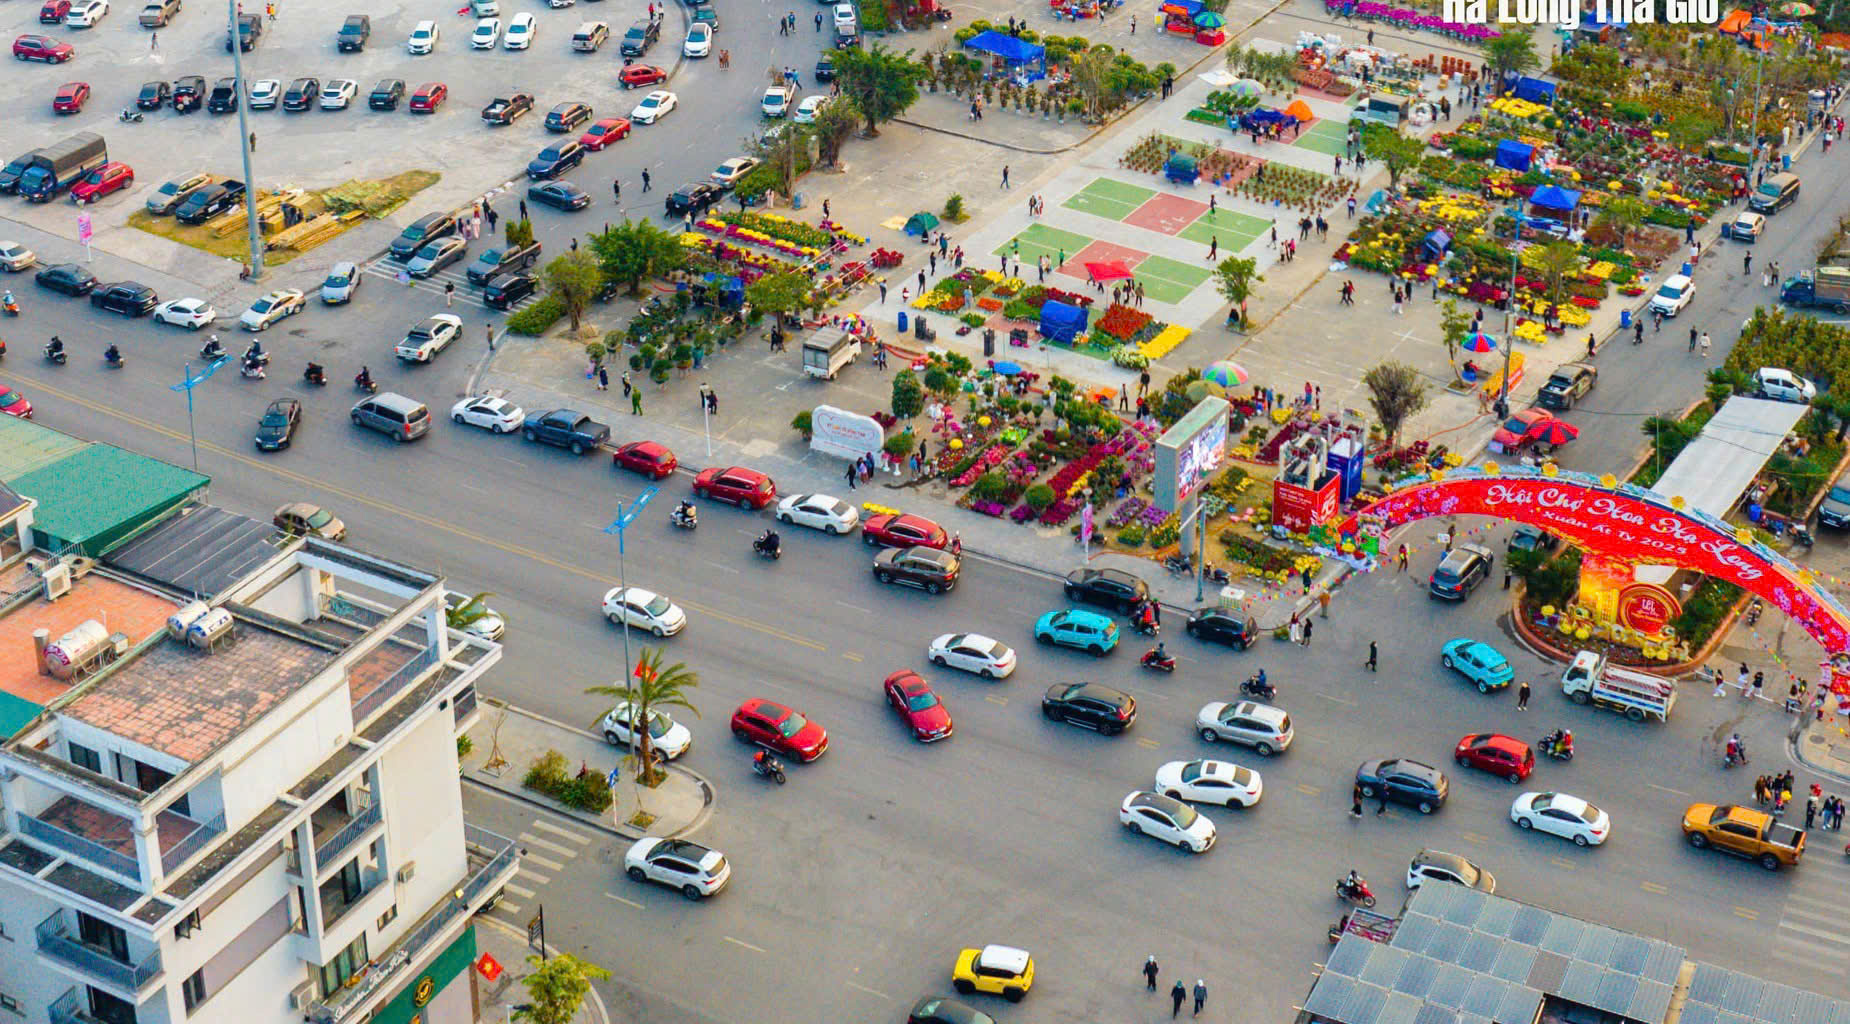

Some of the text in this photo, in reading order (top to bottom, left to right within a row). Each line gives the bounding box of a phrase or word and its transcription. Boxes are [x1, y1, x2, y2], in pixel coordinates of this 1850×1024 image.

[1485, 484, 1533, 506] Hội
[1538, 488, 1585, 512] Chợ
[1587, 498, 1645, 526] Hoa
[1700, 539, 1764, 580] Long
[1640, 536, 1688, 555] 2025
